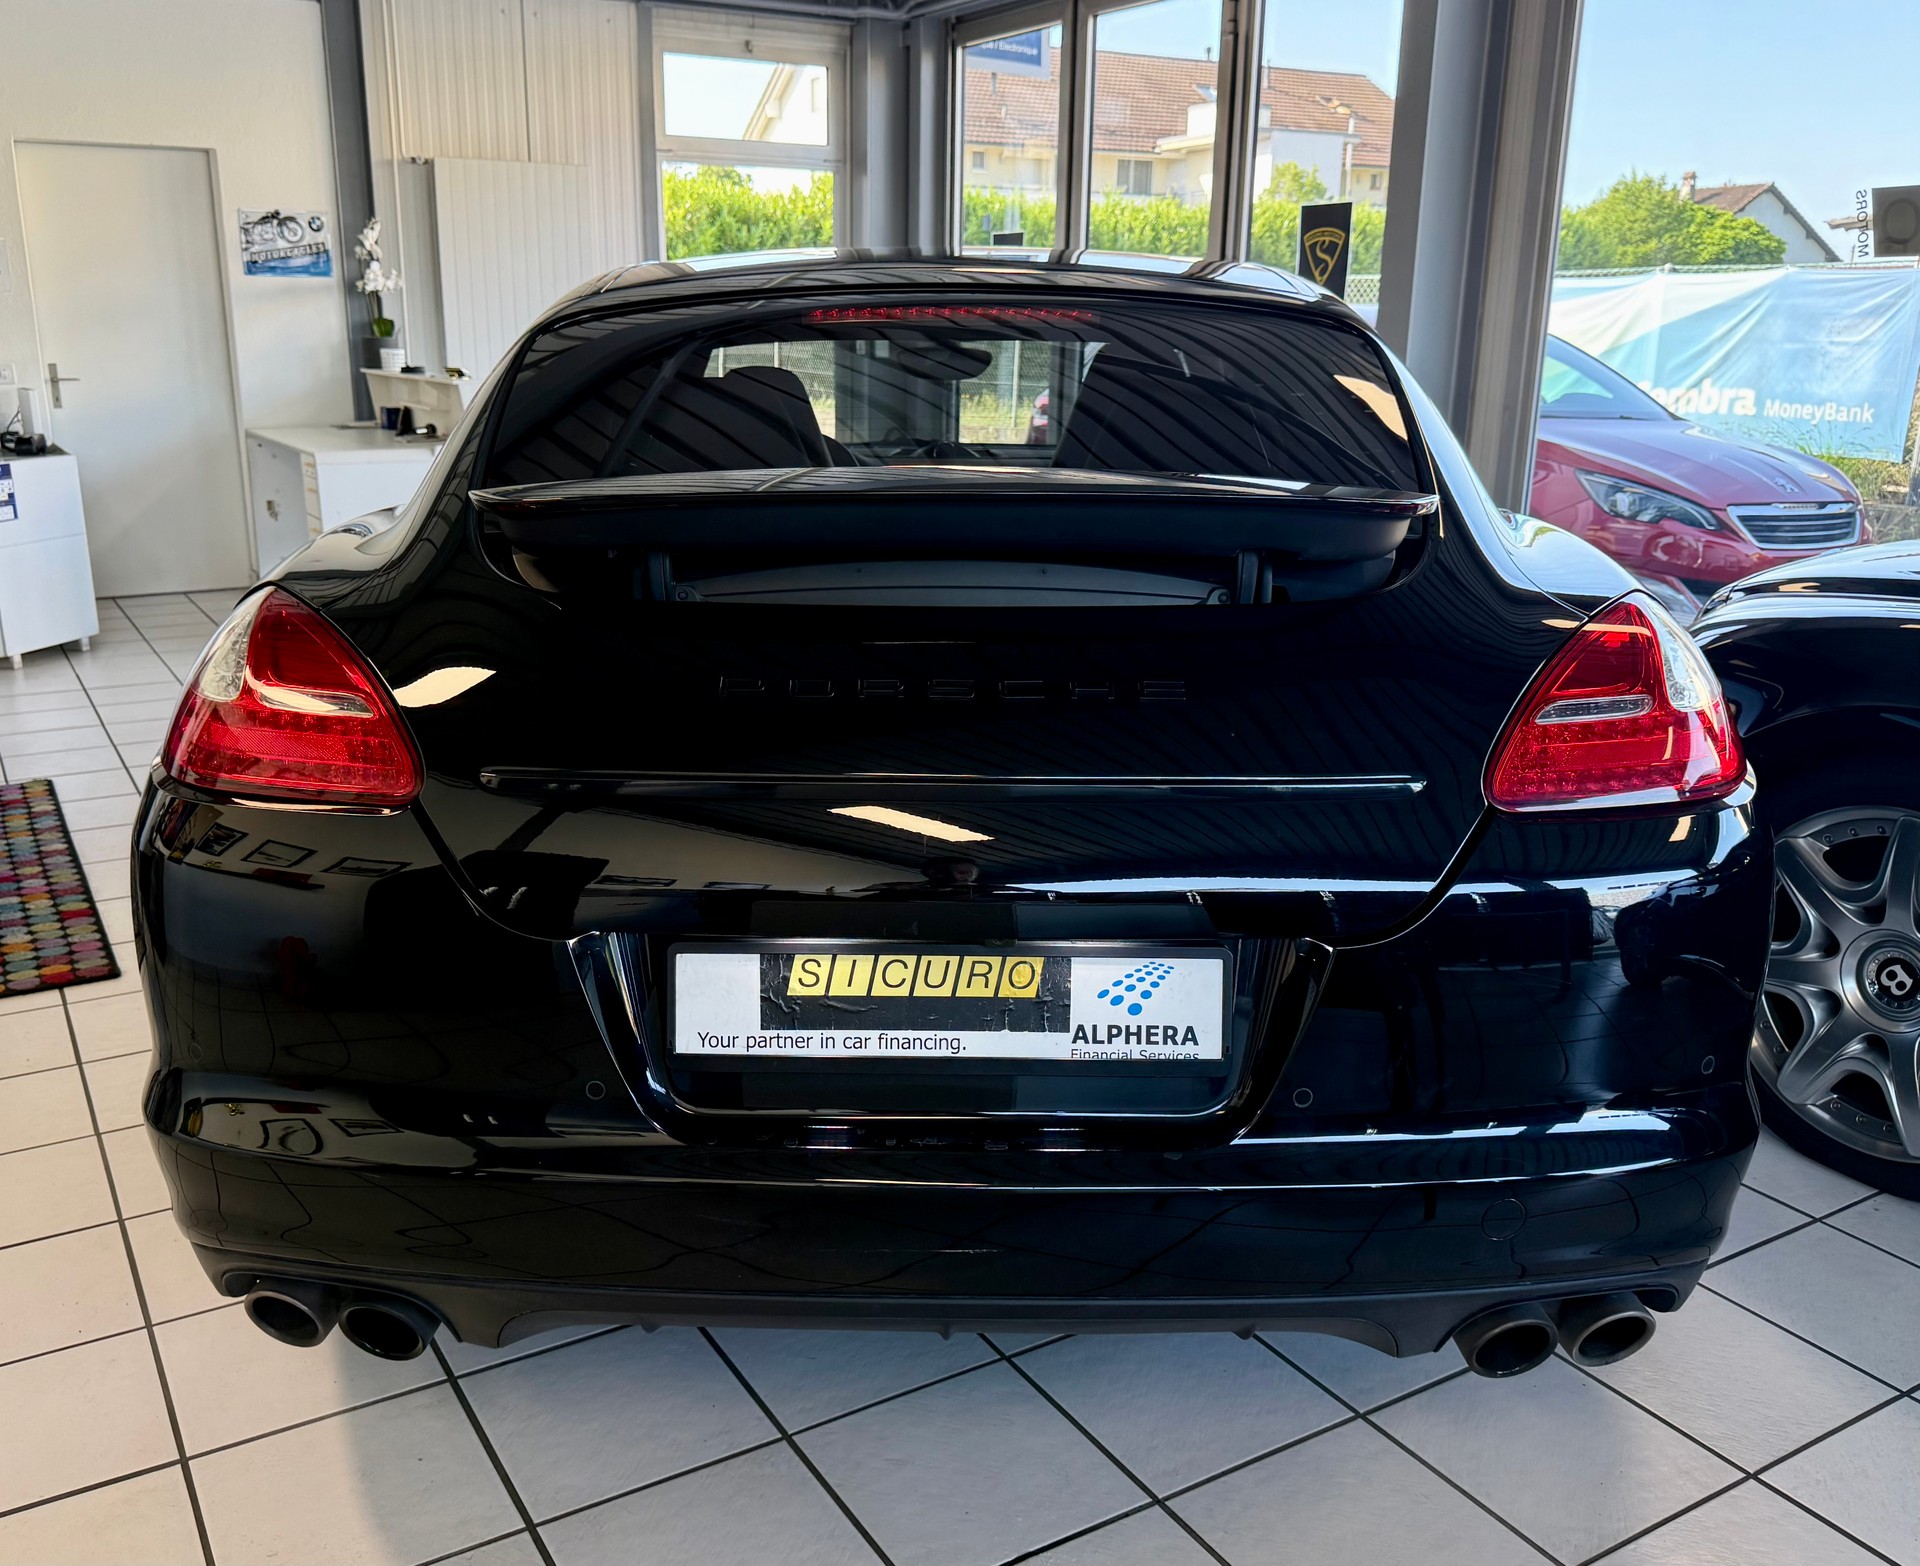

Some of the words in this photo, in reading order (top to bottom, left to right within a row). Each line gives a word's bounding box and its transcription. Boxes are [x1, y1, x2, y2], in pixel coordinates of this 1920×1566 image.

[1638, 378, 1756, 416] embra
[1763, 397, 1875, 425] MoneyBank
[719, 676, 1186, 700] PORSCHE
[797, 957, 1037, 990] SICURO
[697, 1032, 740, 1049] Your
[746, 1033, 814, 1053] partner
[820, 1033, 836, 1049] in
[842, 1036, 872, 1050] car
[877, 1033, 966, 1055] financing.
[1071, 1024, 1200, 1046] ALPHERA
[1070, 1048, 1133, 1060] Financial
[1139, 1049, 1200, 1061] Services
